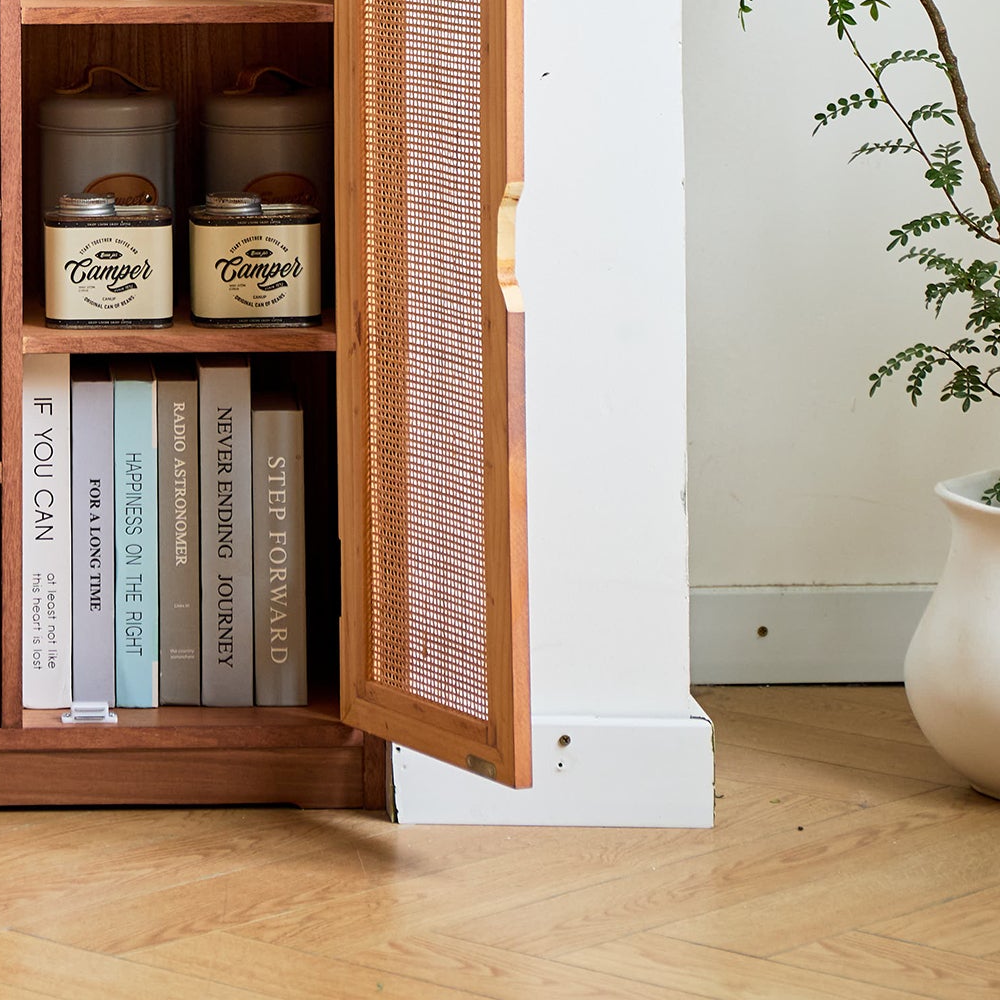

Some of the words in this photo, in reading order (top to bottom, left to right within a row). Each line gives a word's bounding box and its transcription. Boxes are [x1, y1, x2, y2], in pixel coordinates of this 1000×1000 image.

[114, 238, 130, 248] COFFEE
[265, 236, 280, 246] COFFEE
[64, 258, 153, 288] Camper
[215, 256, 303, 286] Camper
[83, 296, 103, 309] ORIGINAL
[120, 295, 135, 306] BEANS
[234, 294, 254, 307] ORIGINAL
[271, 293, 286, 304] BEANS
[33, 397, 53, 416] IF
[173, 402, 186, 452] RADIO
[217, 407, 233, 475] NEVER
[33, 427, 53, 477] YOU
[89, 478, 101, 509] FOR
[125, 452, 143, 536] HAPPINESS
[267, 456, 287, 520] STEP
[34, 489, 54, 540] CAN
[89, 512, 101, 523] A
[174, 457, 188, 567] ASTRONOMER
[217, 481, 234, 559] ENDING
[89, 526, 102, 569] LONG
[125, 543, 143, 566] ON
[32, 573, 42, 593] this
[47, 573, 57, 585] at
[89, 573, 102, 612] TIME
[125, 574, 143, 603] THE
[47, 590, 57, 620] least
[268, 531, 288, 665] FORWARD
[32, 597, 42, 631] heart
[217, 574, 234, 669] JOURNEY
[32, 635, 43, 645] is
[47, 625, 57, 644] not
[125, 611, 143, 656] RIGHT
[32, 649, 43, 670] lost
[47, 649, 58, 669] like
